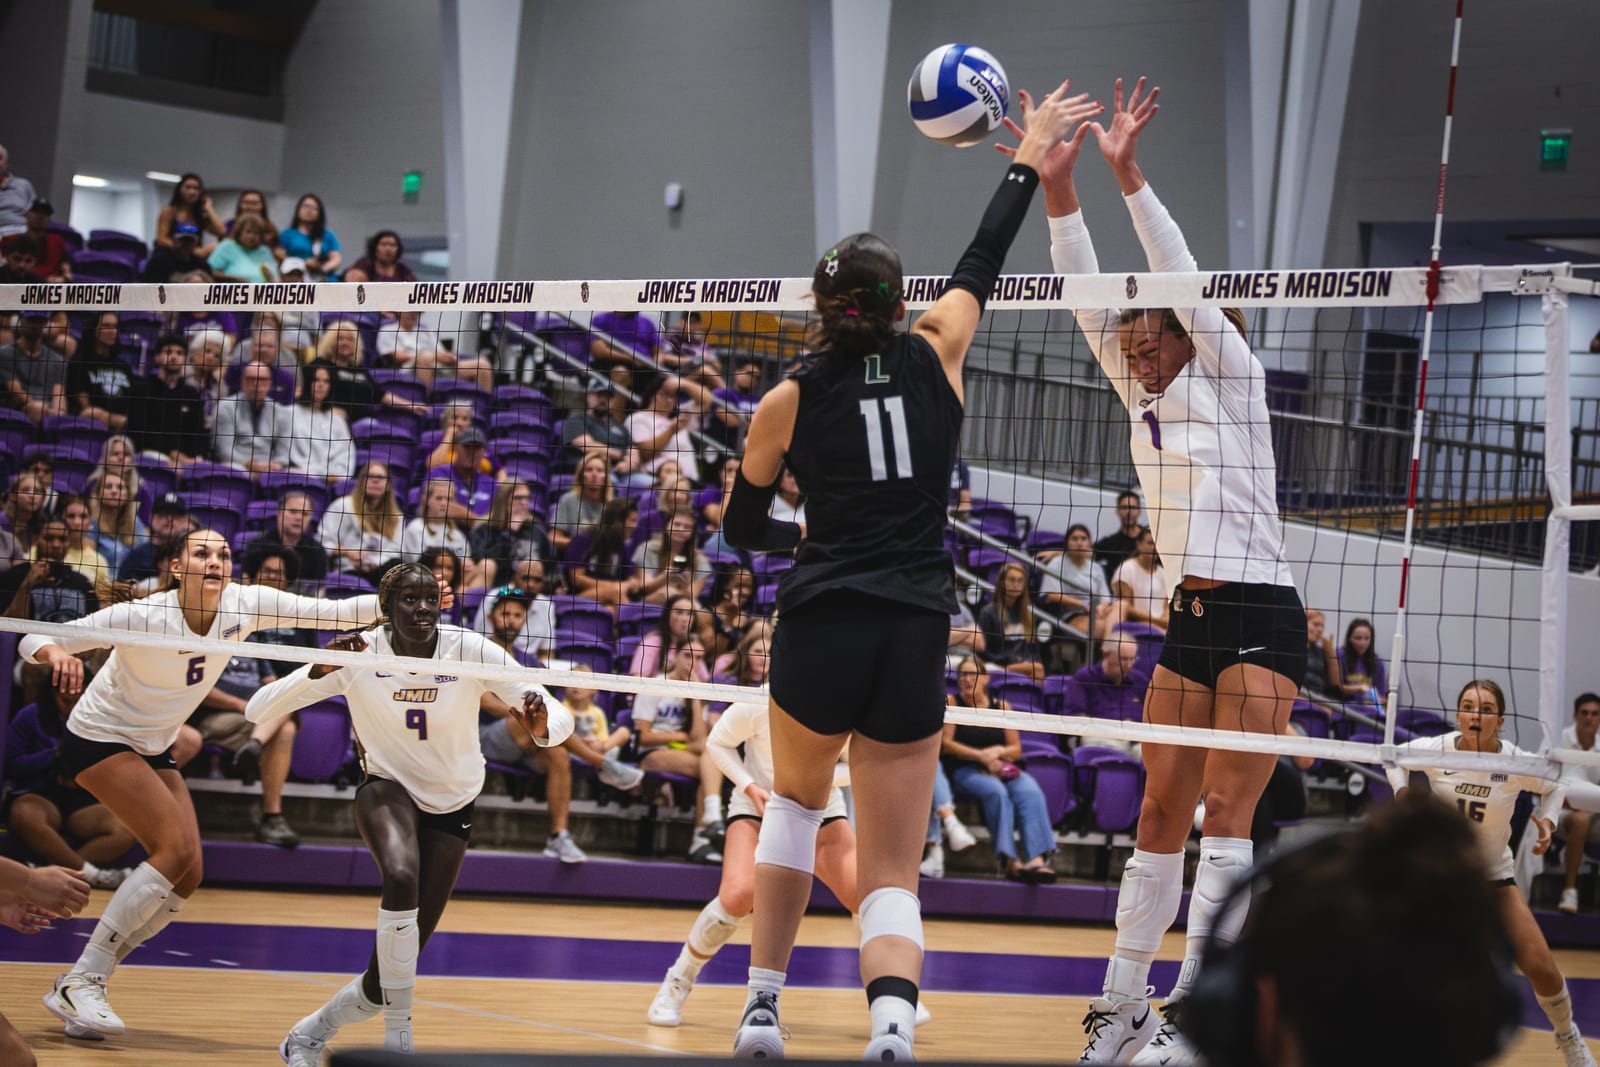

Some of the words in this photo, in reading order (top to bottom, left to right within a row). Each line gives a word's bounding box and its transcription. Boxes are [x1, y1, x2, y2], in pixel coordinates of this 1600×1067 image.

[970, 76, 1001, 121] molten
[21, 286, 62, 304] JAMES
[65, 286, 121, 304] MADISON
[204, 285, 249, 305] JAMES
[253, 285, 316, 304] MADISON
[408, 283, 459, 304] JAMES
[462, 282, 534, 304] MADISON
[638, 281, 696, 303] JAMES
[700, 280, 781, 303] MADISON
[902, 278, 951, 302] JAM
[989, 277, 1065, 301] ADISON
[1202, 273, 1279, 299] JAMES
[1284, 271, 1392, 298] MADISON
[864, 354, 891, 385] L
[859, 396, 913, 481] 11
[186, 655, 206, 686] 6
[393, 688, 438, 702] JMU
[406, 709, 427, 740] 9
[1455, 783, 1491, 798] JMU
[1457, 798, 1486, 823] 16
